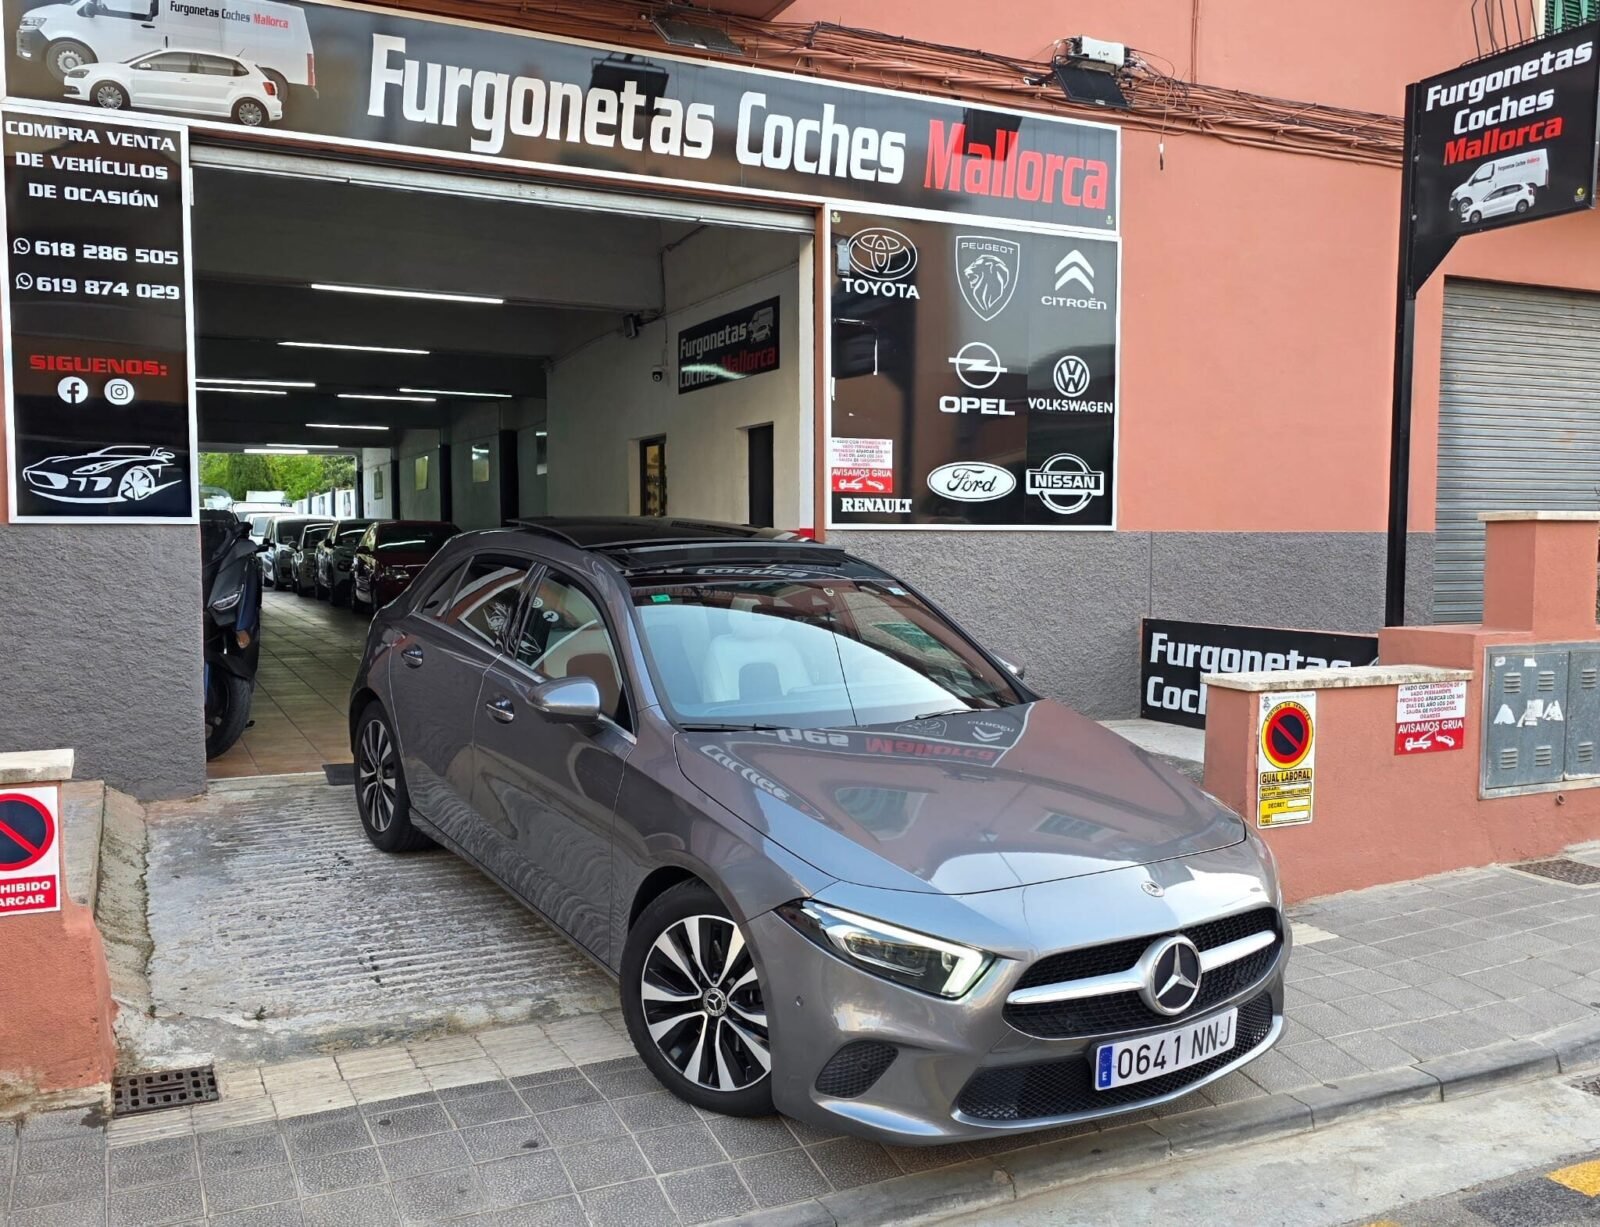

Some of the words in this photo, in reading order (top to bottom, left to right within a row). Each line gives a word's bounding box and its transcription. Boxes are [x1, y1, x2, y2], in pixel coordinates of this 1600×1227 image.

[170, 1, 219, 17] Furgonetas
[222, 8, 250, 22] Coches
[254, 13, 289, 28] Mallorca
[1426, 41, 1593, 112] Furgonetas
[367, 32, 715, 160] Furgonetas
[735, 91, 906, 184] Coches
[923, 119, 1109, 210] Mallorca
[1453, 89, 1555, 135] Coches
[5, 121, 99, 144] COMPRA
[106, 131, 176, 152] VENTA
[1443, 116, 1562, 166] Mallorca
[16, 152, 44, 168] DE
[51, 155, 168, 180] VEHÍCULOS
[28, 182, 56, 199] DE
[64, 187, 158, 208] OCASIÓN
[35, 240, 76, 258] 618
[83, 244, 128, 262] 286
[136, 248, 179, 266] 505
[961, 242, 1015, 255] PEUGEOT
[36, 276, 78, 294] 619
[84, 280, 130, 297] 874
[136, 284, 180, 300] 029
[842, 278, 920, 300] TOYOTA
[680, 322, 747, 360] Furgonetas
[30, 354, 168, 376] SIGUENOS:
[939, 396, 1016, 416] OPEL
[1028, 397, 1114, 414] VOLKSWAGEN
[832, 468, 870, 477] AVISAMOS
[872, 470, 892, 478] GRUA
[946, 468, 997, 492] Ford
[1034, 475, 1095, 489] NISSAN
[841, 498, 912, 514] RENAULT
[1398, 721, 1440, 734] AVISAMOS
[1442, 720, 1463, 730] GRUA
[1262, 773, 1279, 783] GUAL
[1282, 770, 1310, 781] LABORAL
[1118, 1035, 1181, 1080] 0641
[1191, 1016, 1232, 1060] NNJ
[1102, 1071, 1108, 1080] E
